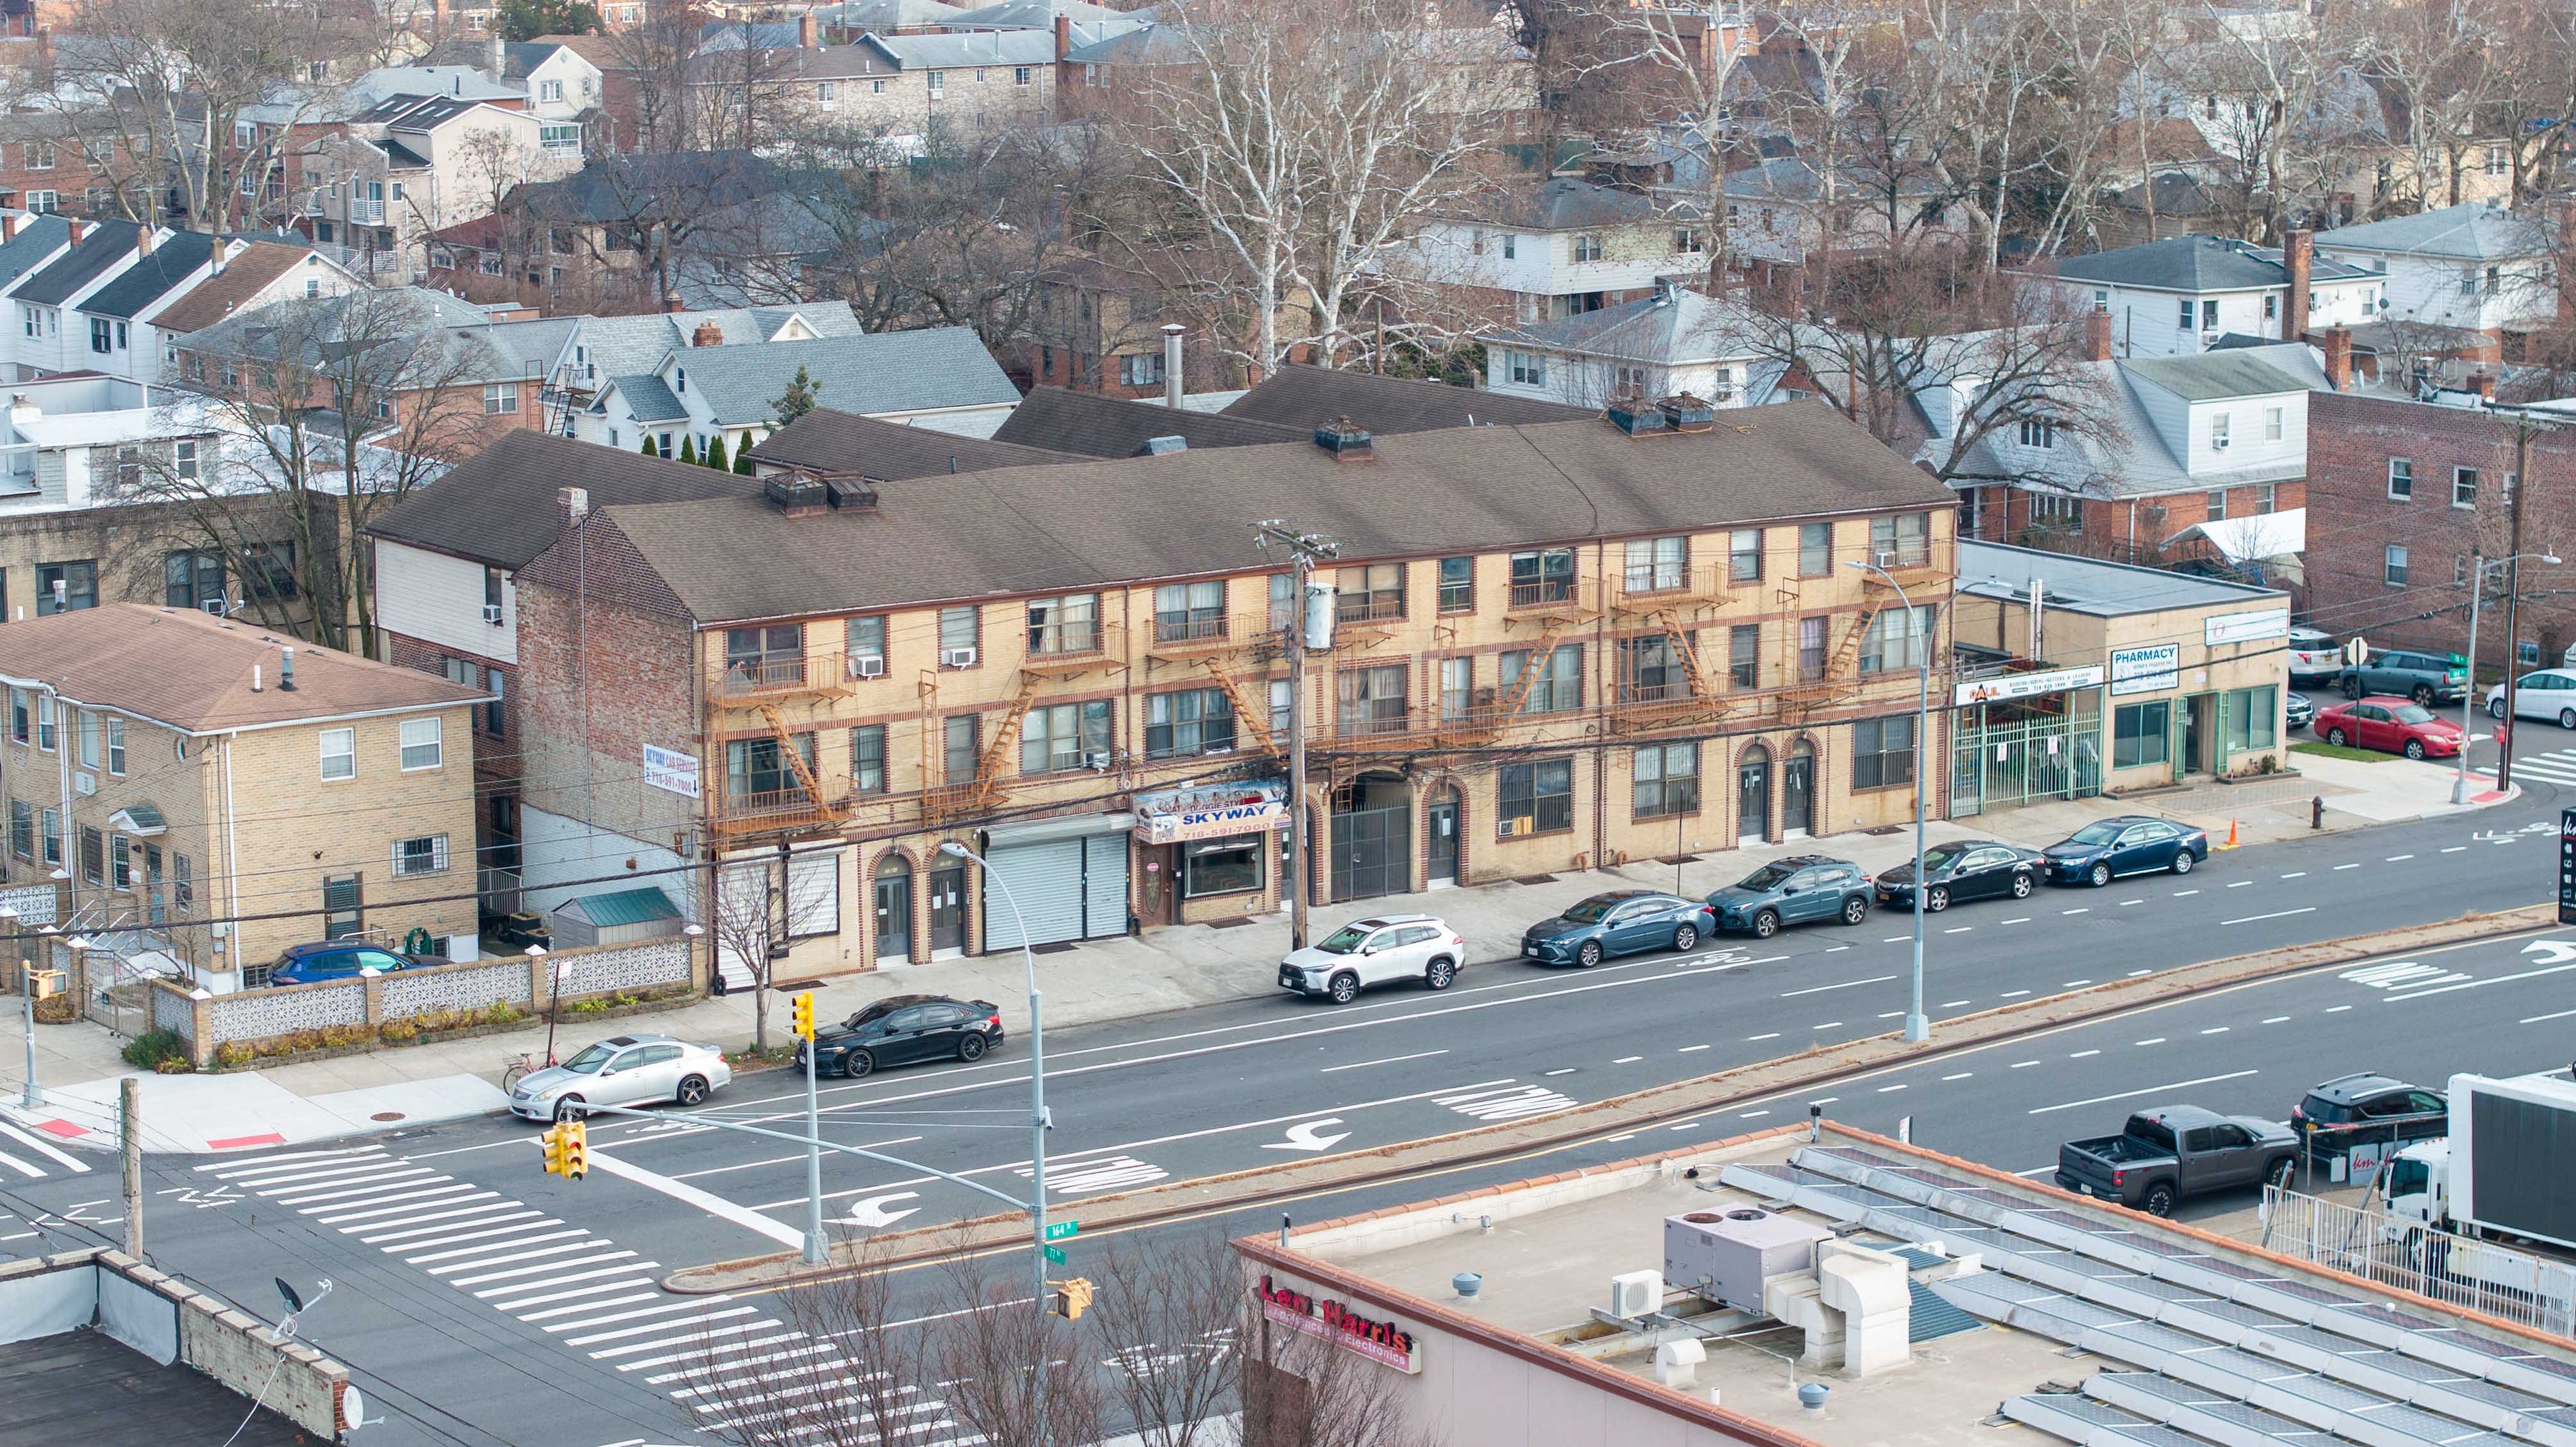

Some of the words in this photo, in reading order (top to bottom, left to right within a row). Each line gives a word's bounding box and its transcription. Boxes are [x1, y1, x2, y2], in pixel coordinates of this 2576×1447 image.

[2115, 647, 2175, 664] PHARMACY
[1183, 806, 1268, 825] SKYWAY
[1184, 823, 1270, 839] 718-591-7000
[1052, 1224, 1065, 1237] 164
[1260, 1276, 1313, 1316] Len
[1345, 1333, 1405, 1365] Electronics
